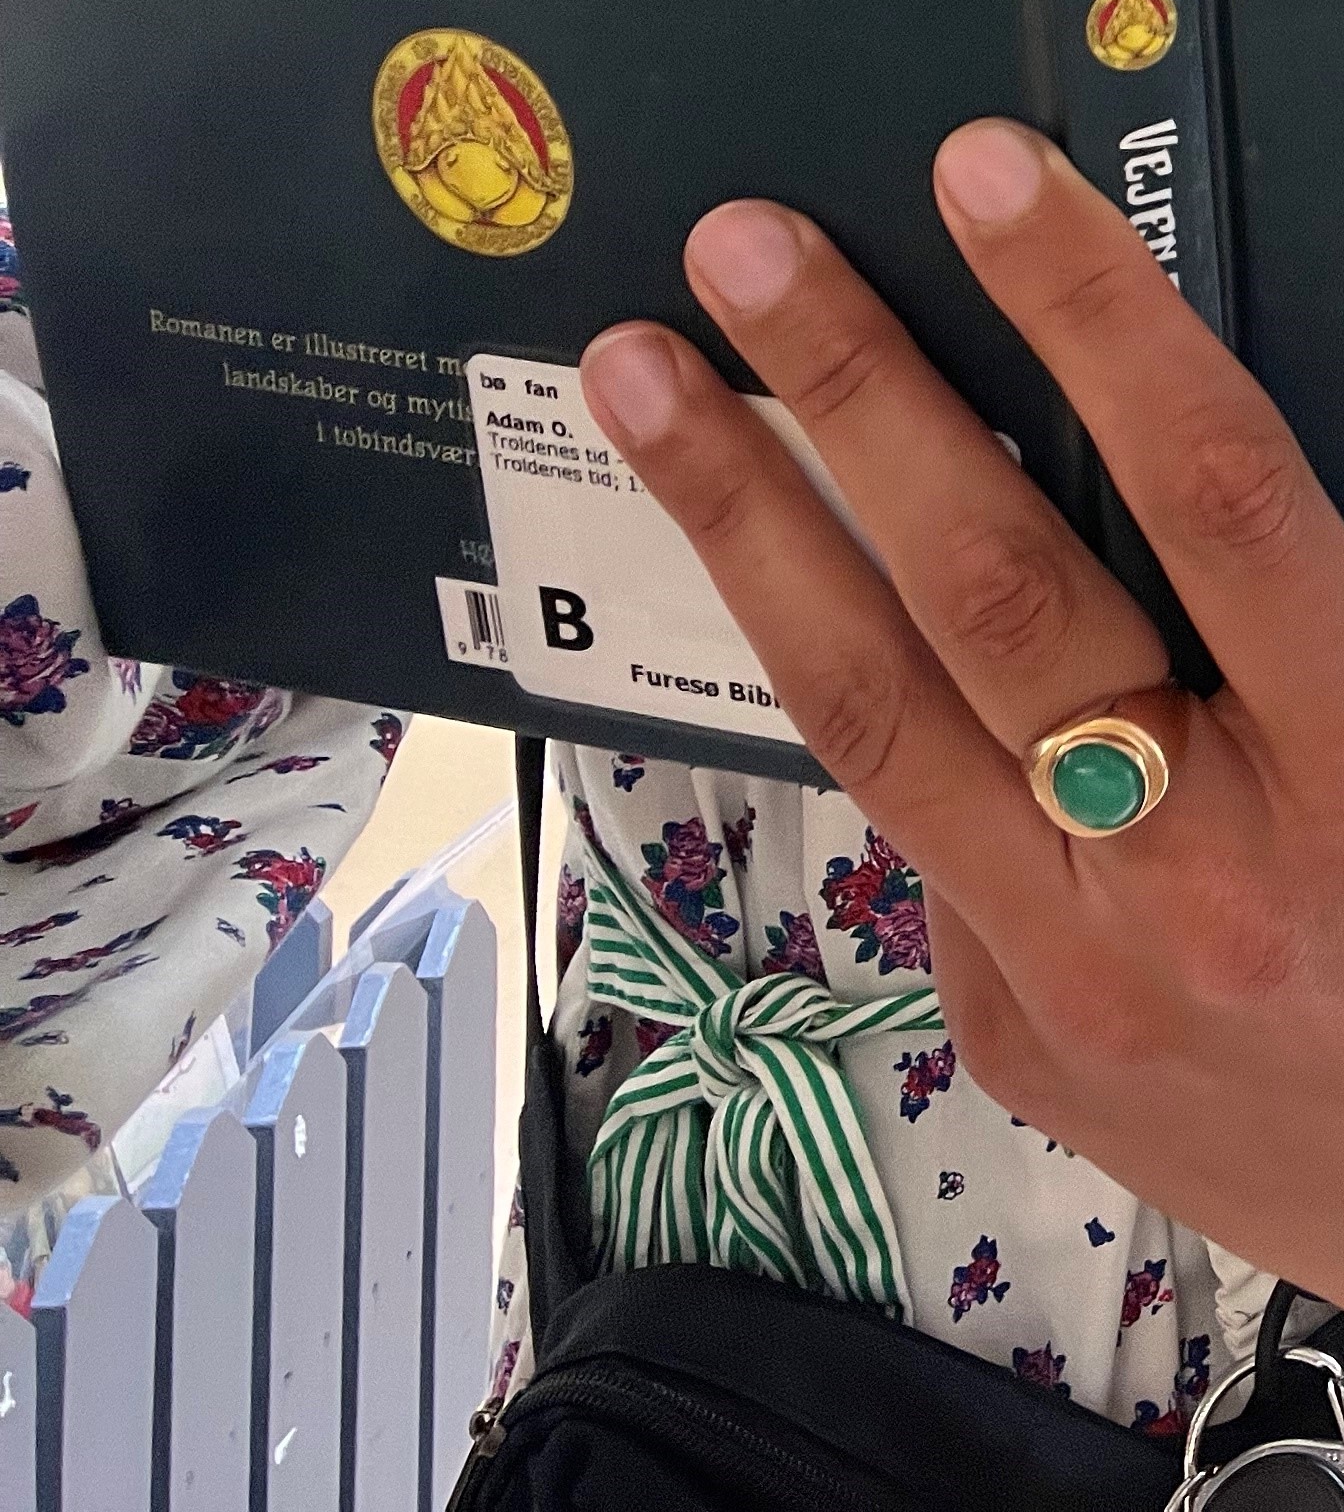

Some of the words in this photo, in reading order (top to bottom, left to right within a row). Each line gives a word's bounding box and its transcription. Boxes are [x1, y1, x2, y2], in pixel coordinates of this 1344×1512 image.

[150, 309, 264, 347] Romanen
[271, 333, 297, 352] er
[304, 332, 428, 372] illustreret
[437, 355, 467, 378] m
[223, 362, 360, 404] landskaber
[367, 389, 398, 416] og
[524, 379, 559, 400] fan
[486, 411, 544, 434] Adam
[551, 420, 574, 439] O.
[334, 425, 478, 467] tobindsvær
[488, 432, 580, 462] Troldenes
[585, 448, 609, 467] tid
[491, 452, 582, 484] Troldenes
[588, 469, 620, 492] tid;
[538, 585, 595, 652] B
[630, 663, 720, 698] Furesø
